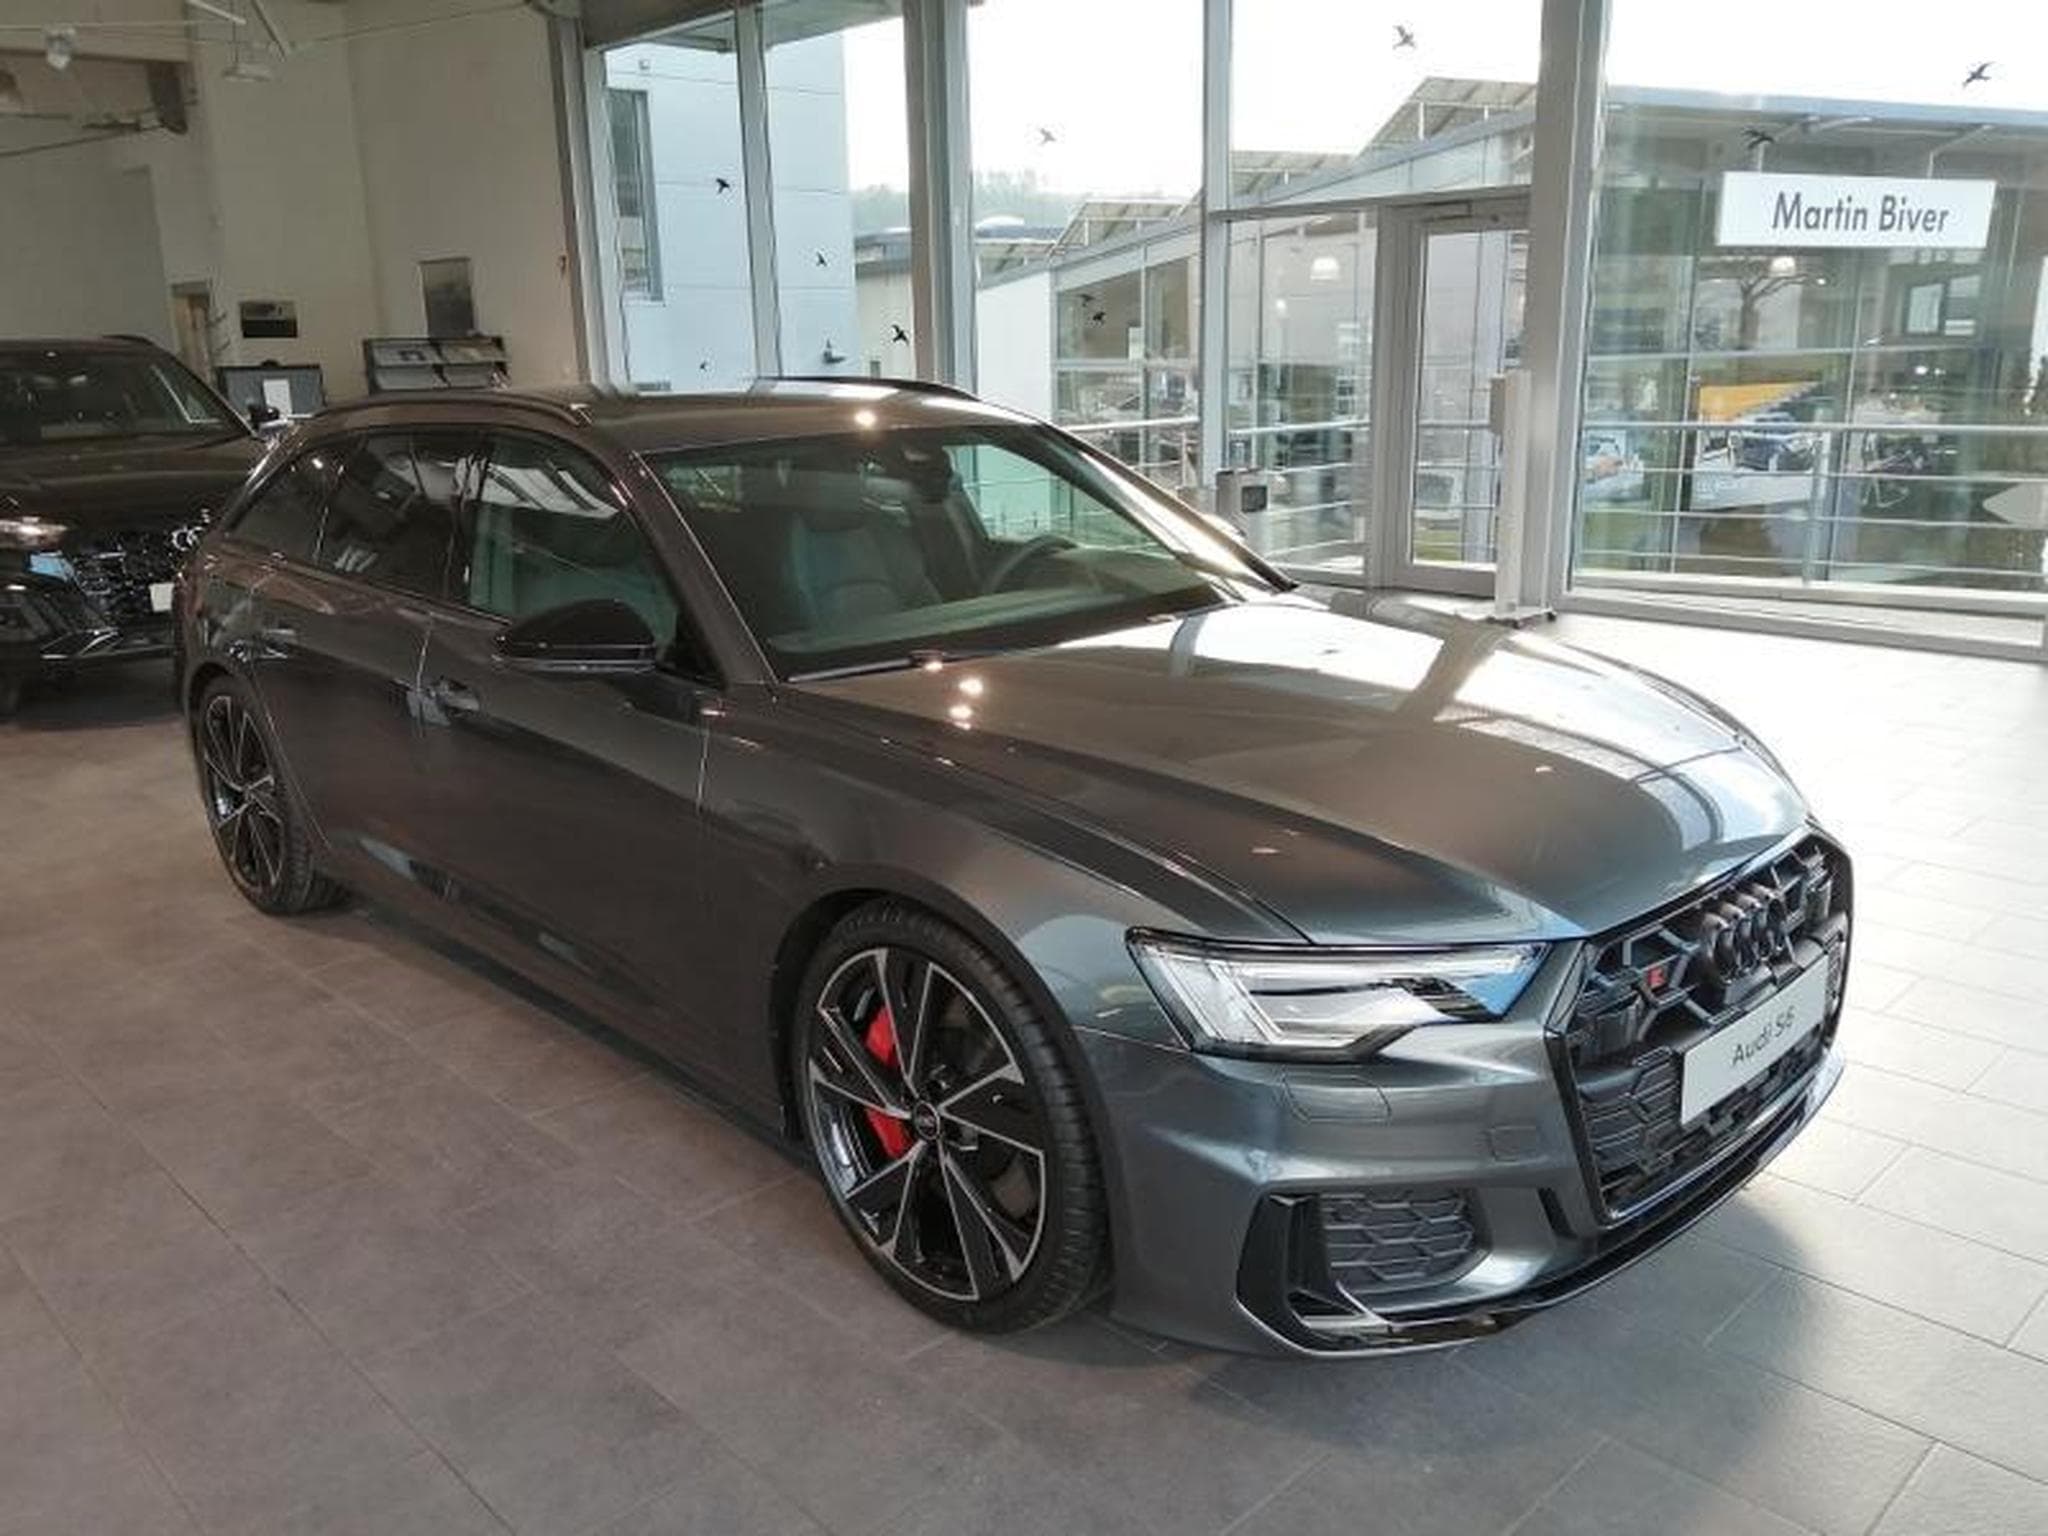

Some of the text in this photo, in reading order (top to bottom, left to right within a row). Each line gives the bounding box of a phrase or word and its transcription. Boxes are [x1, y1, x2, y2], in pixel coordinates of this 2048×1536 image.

[1772, 191, 1949, 232] Martin Biver
[1732, 1021, 1772, 1067] Audi
